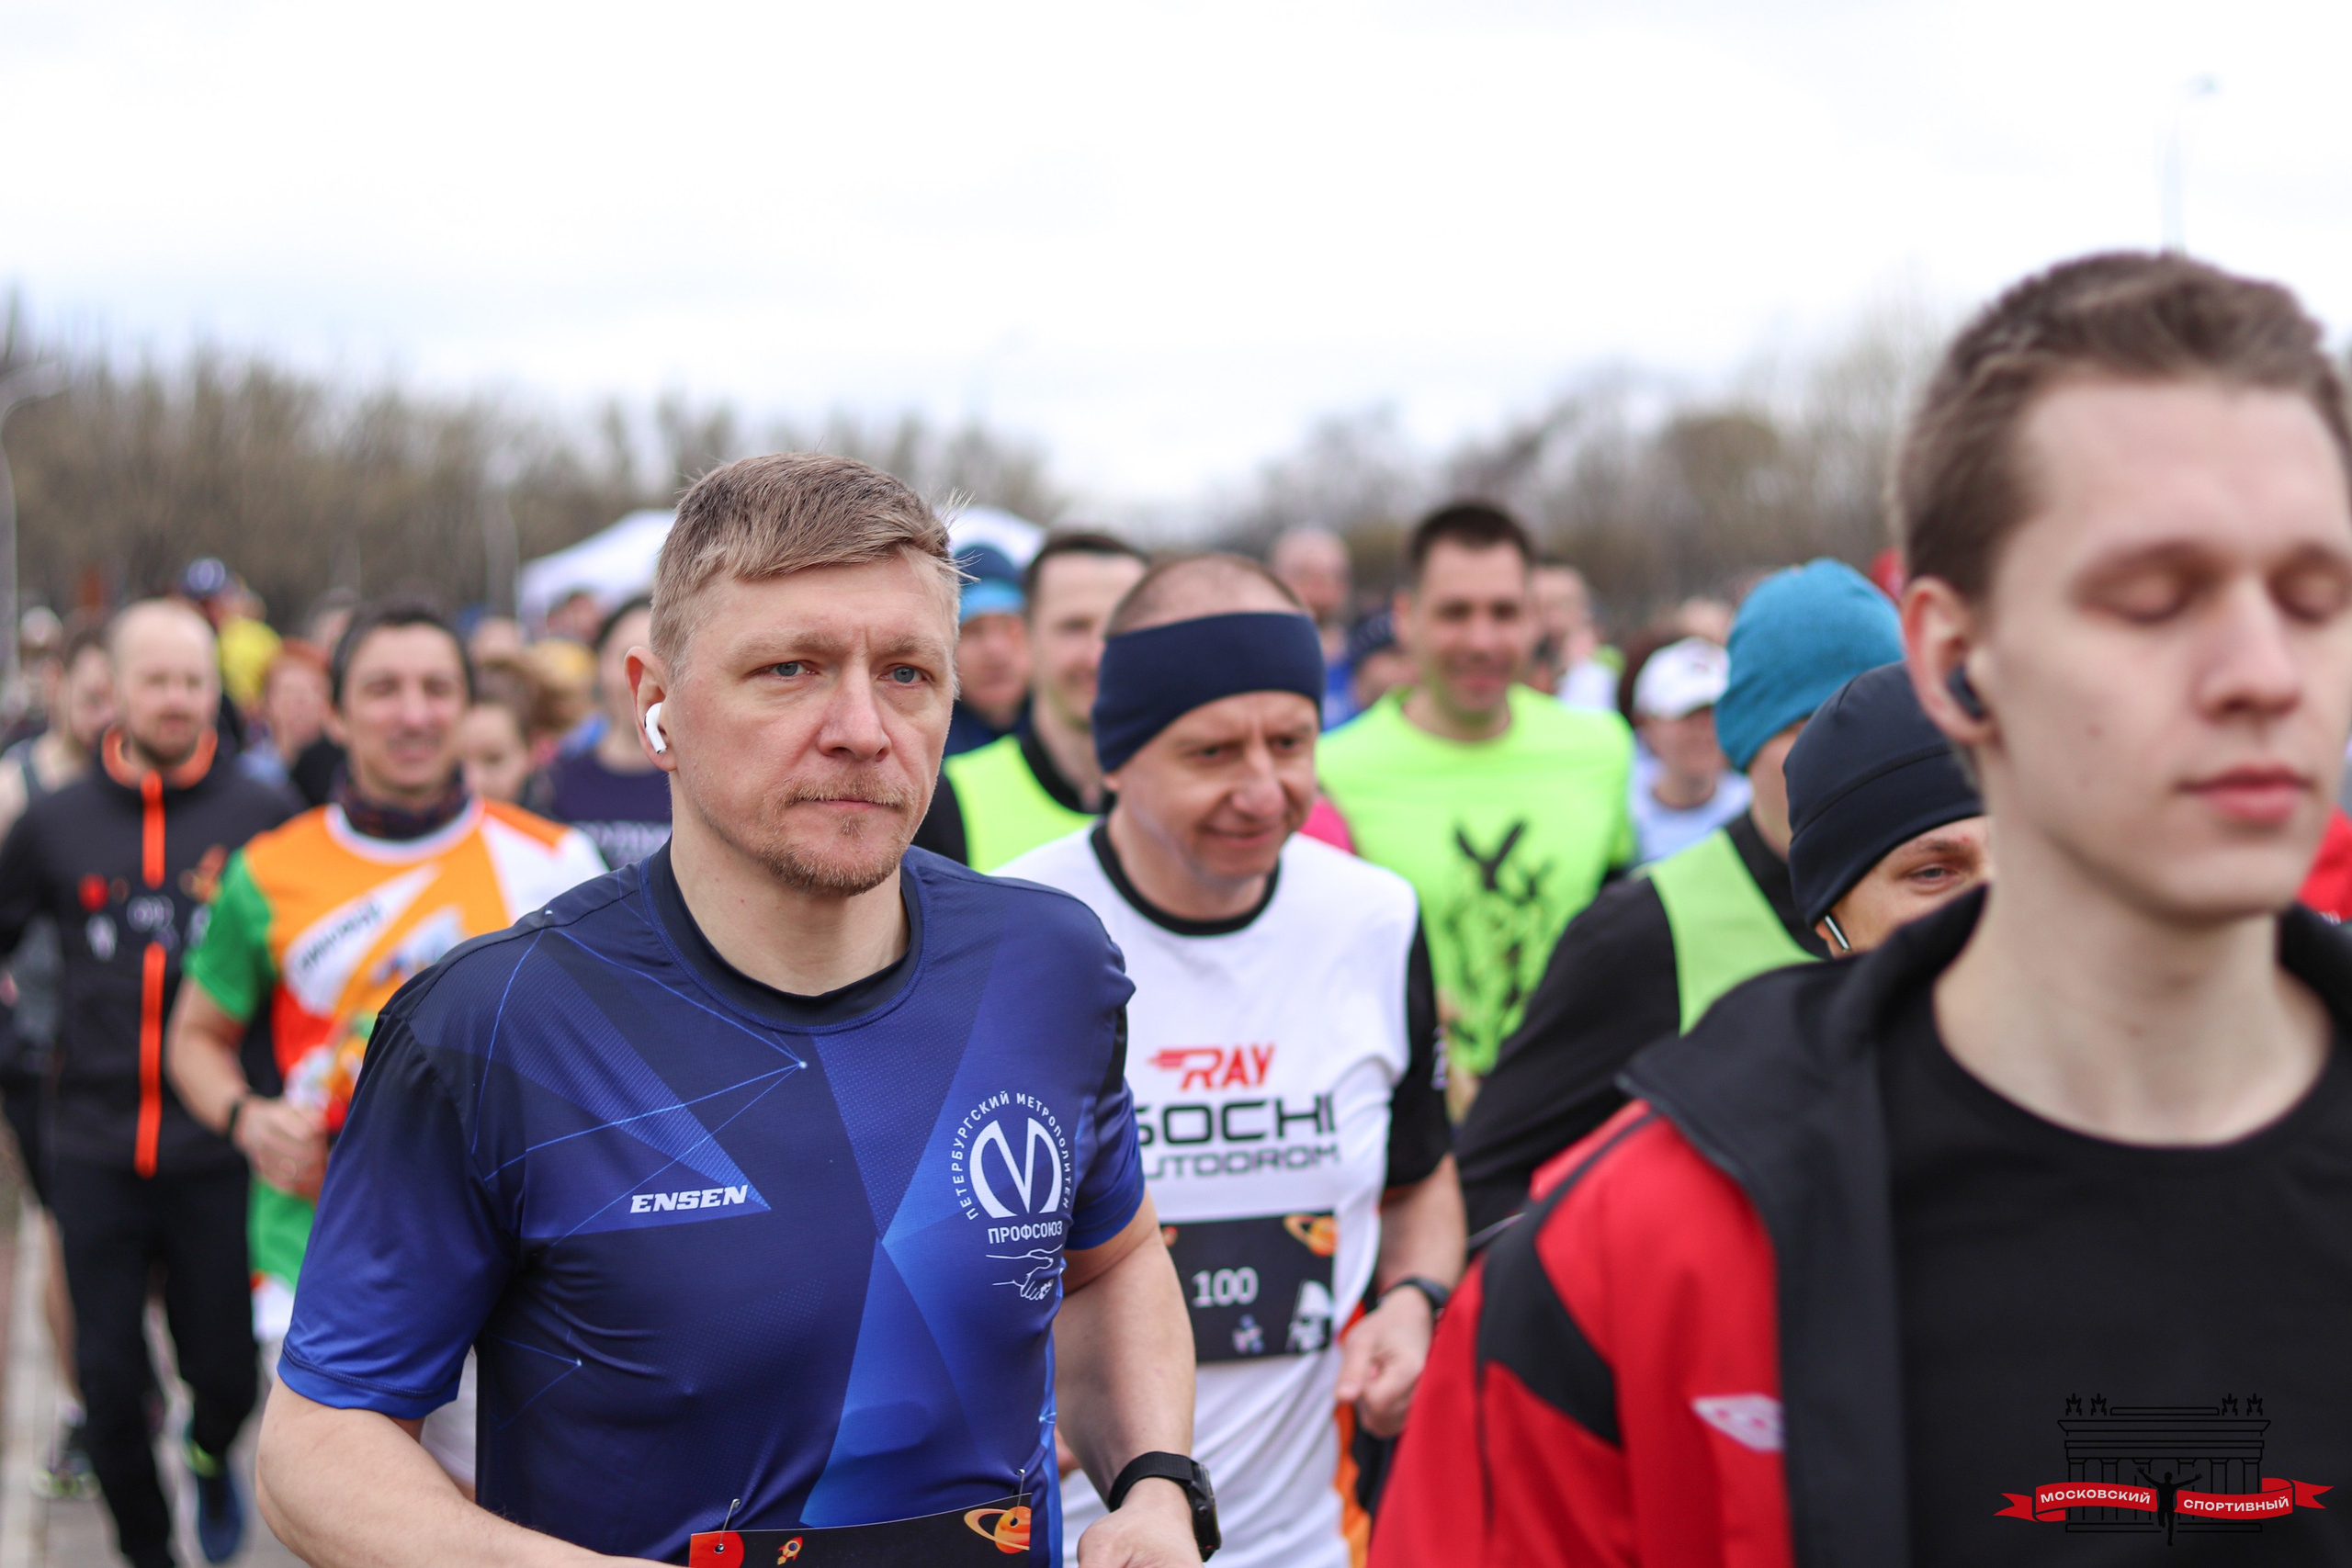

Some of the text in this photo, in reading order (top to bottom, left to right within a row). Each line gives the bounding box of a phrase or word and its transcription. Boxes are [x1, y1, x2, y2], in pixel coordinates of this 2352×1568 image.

[1148, 1044, 1275, 1091] RAY
[952, 1090, 1071, 1220] ПЕТЕРБУРГСКИЙ МЕТРОПОЛИТЕН
[1145, 1145, 1340, 1180] UTODROM
[630, 1185, 748, 1213] ENSEN
[988, 1221, 1063, 1245] ПРОФСОЮЗ
[1192, 1266, 1259, 1308] 100
